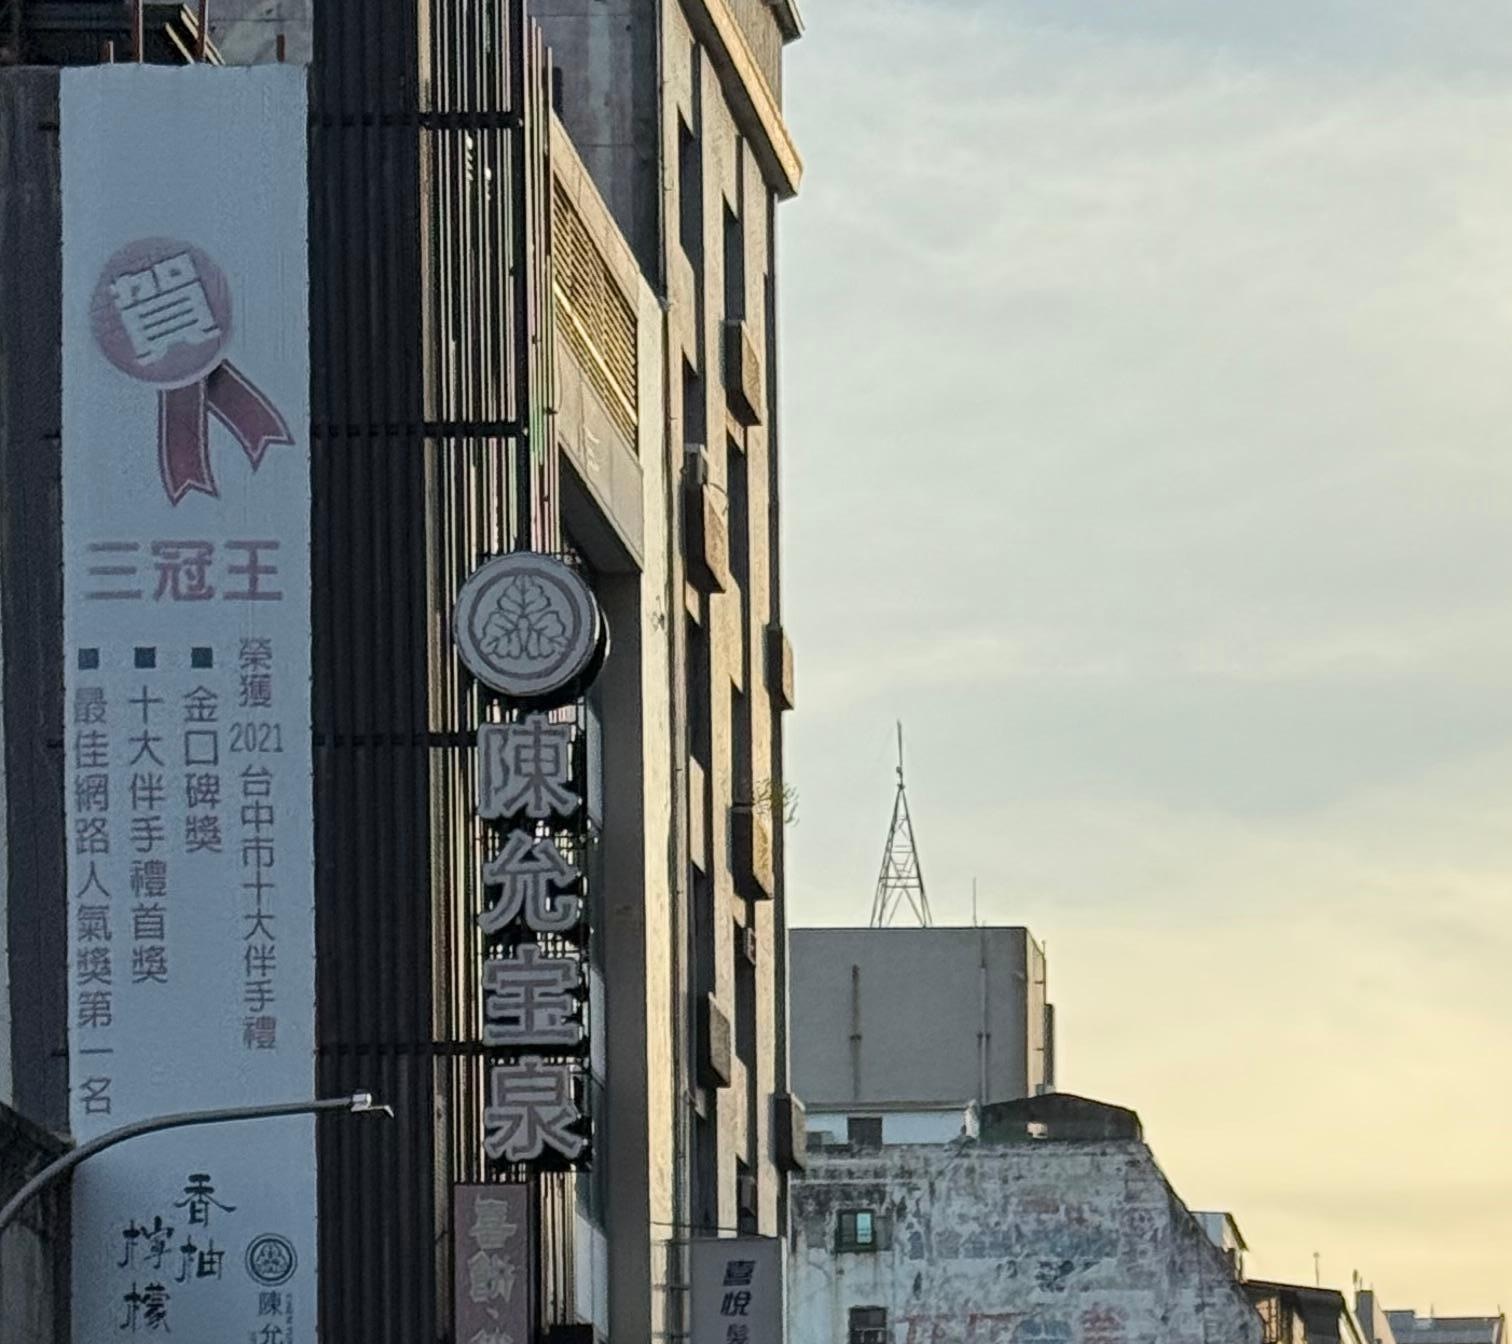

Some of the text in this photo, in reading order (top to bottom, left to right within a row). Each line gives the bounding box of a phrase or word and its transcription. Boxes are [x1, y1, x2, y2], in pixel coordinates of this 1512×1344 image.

[86, 538, 284, 601] 三冠王
[127, 684, 169, 985] 十大伴手禮首獎
[183, 685, 223, 854] 金口碑獎
[73, 687, 114, 1116] 最佳網路人氣獎第一名
